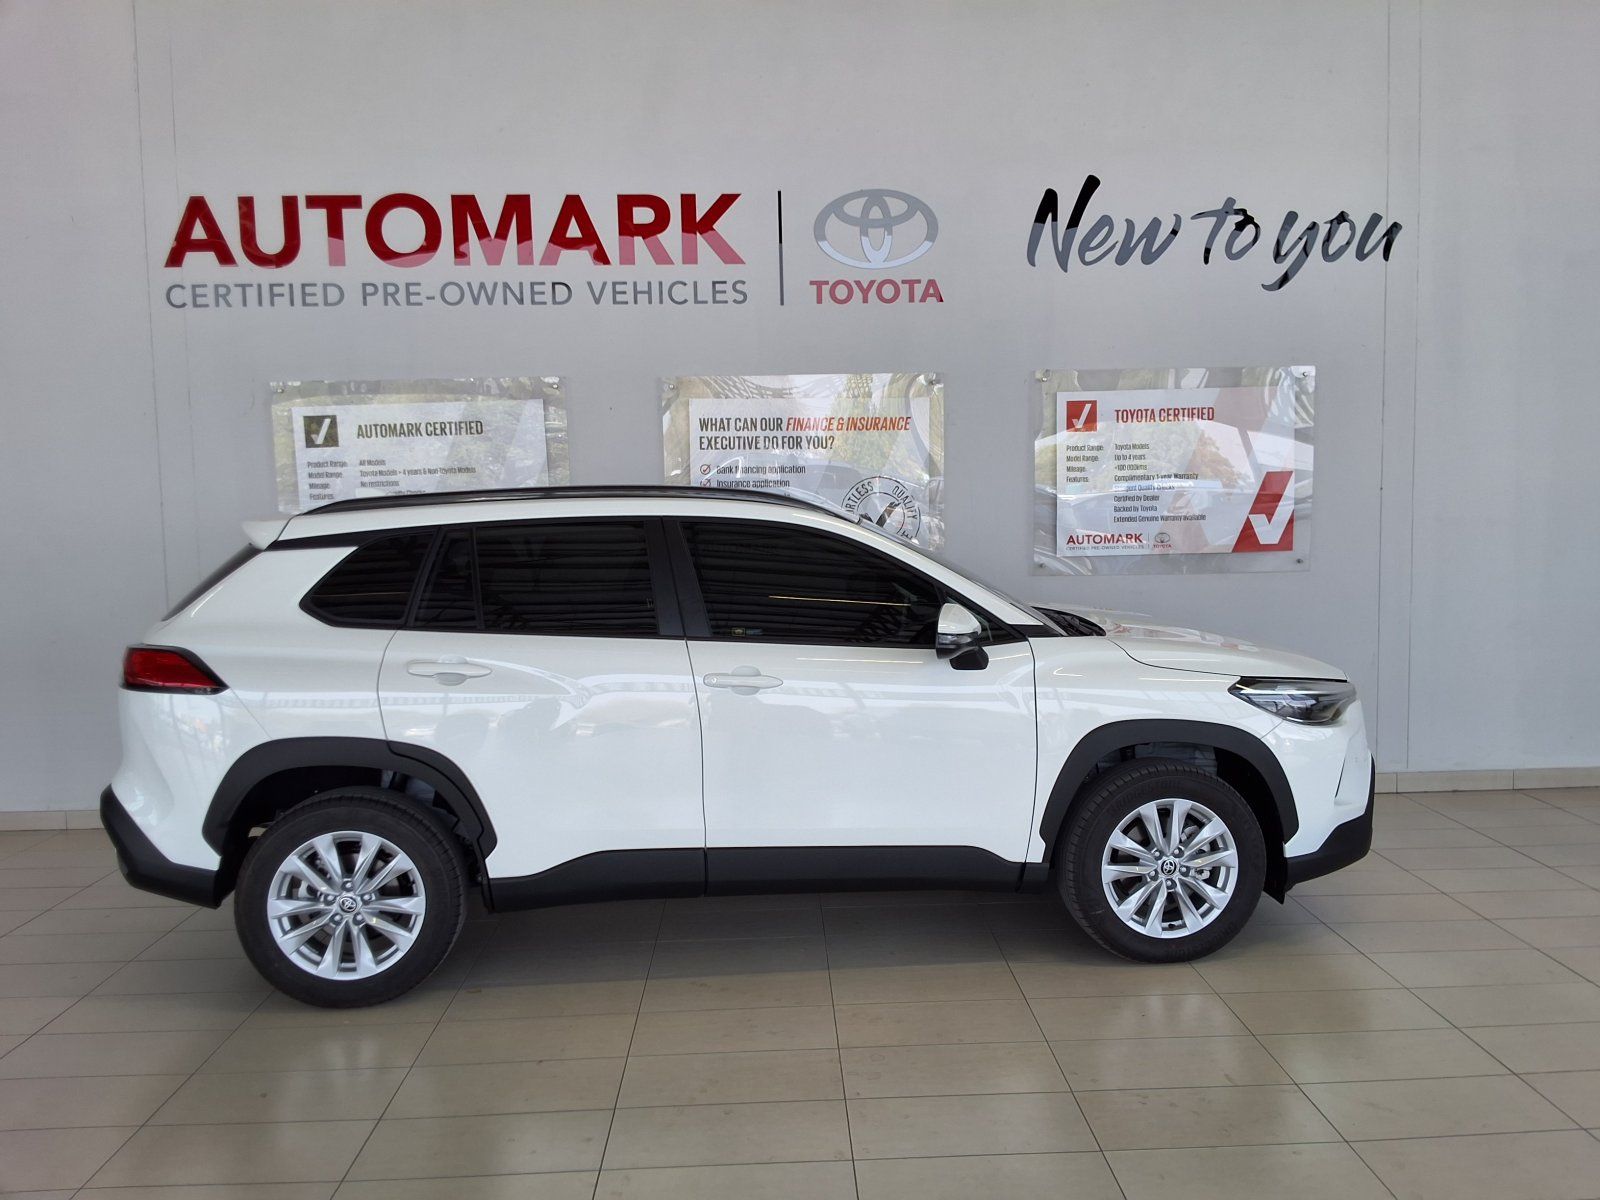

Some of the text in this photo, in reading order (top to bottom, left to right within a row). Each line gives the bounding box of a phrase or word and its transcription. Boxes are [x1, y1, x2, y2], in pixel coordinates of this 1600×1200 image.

[164, 192, 746, 268] AUTOMARK
[1027, 175, 1402, 292] New to you
[165, 278, 748, 308] CERTIFIED PRE-OWNED VEHICLES
[809, 278, 944, 304] TOYOTA
[1115, 406, 1215, 424] TOYOTA CERTIFIED
[357, 420, 484, 439] AUTOMARK CERTIFIED
[699, 416, 911, 432] WHAT CAN OUR FINANCE & INSURANCE
[699, 435, 835, 451] EXECUTIVE DO FOR YOU?
[1114, 442, 1150, 451] Toyota Models
[1132, 453, 1146, 461] years
[734, 465, 767, 476] fnancing
[768, 464, 806, 475] application
[717, 479, 790, 489] Insurance application
[1114, 474, 1155, 482] Complimentary
[1113, 495, 1135, 503] Certified
[1143, 494, 1160, 502] Dealer
[1113, 505, 1132, 513] Backed
[1140, 504, 1158, 512] Toyota
[1113, 513, 1207, 523] Extended Genuine Warranty available
[1066, 533, 1144, 545] AUTOMARK
